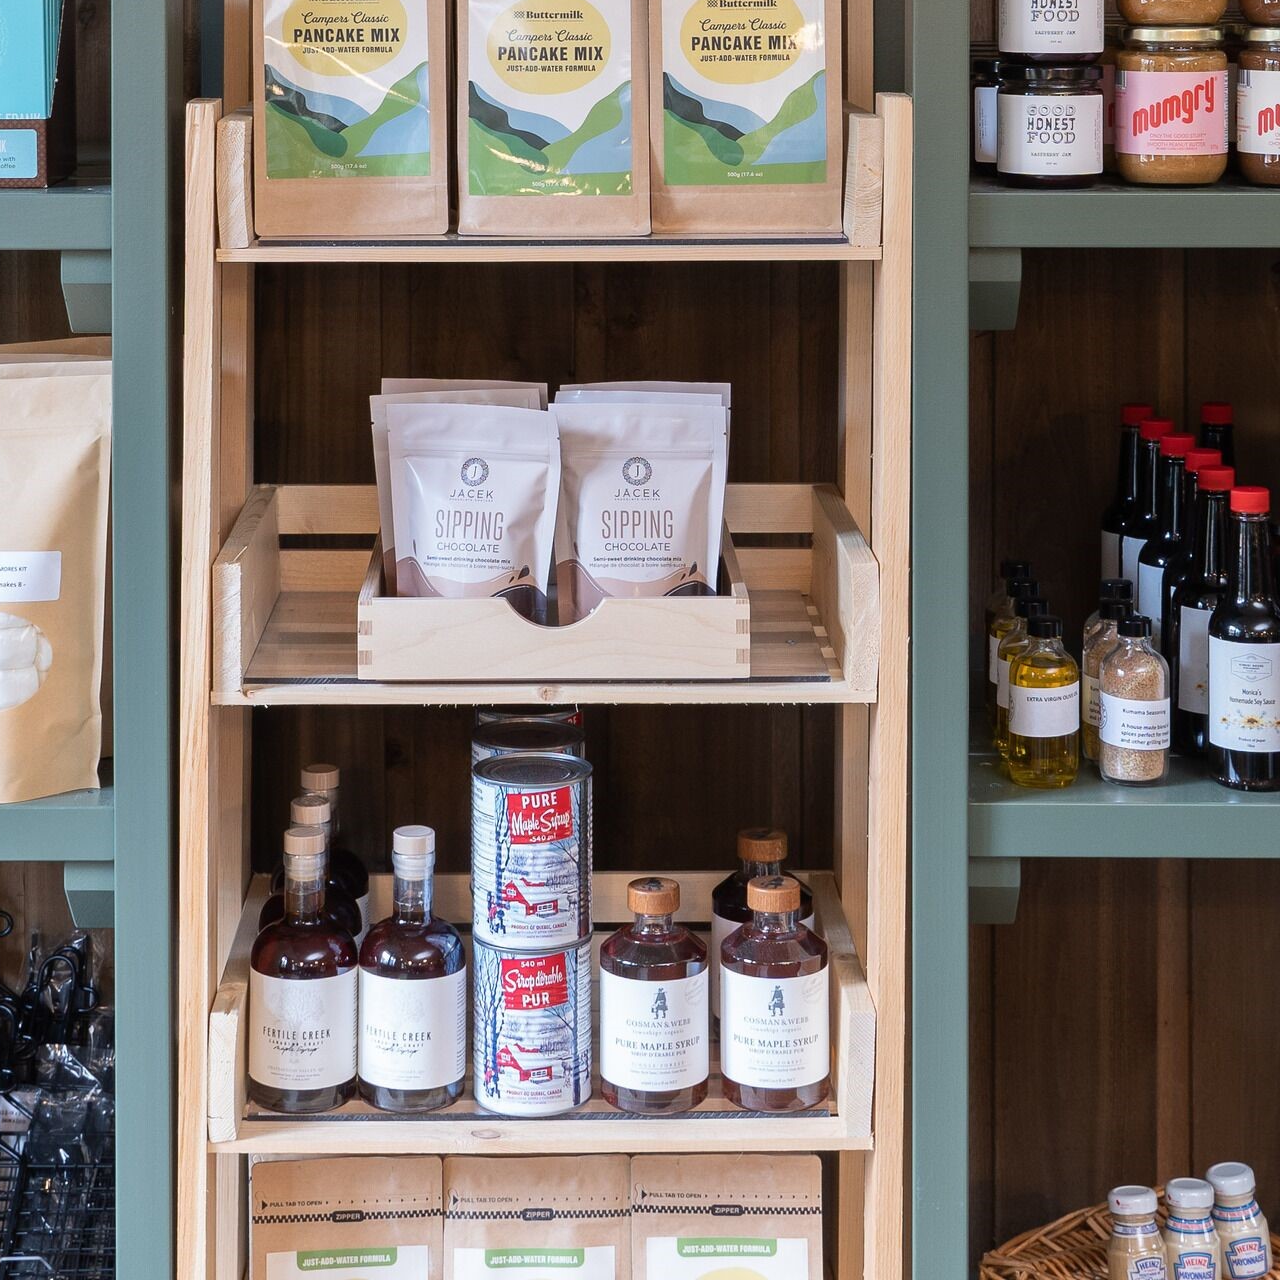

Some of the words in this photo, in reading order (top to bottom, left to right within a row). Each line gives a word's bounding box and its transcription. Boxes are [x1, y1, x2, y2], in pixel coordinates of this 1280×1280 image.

[302, 12, 349, 26] Campers
[351, 11, 389, 23] Classic
[526, 11, 583, 19] Buttermilk
[1031, 10, 1080, 22] FOOD
[699, 19, 746, 33] Campers
[749, 18, 787, 31] Classic
[294, 29, 364, 42] PANCAKE
[371, 29, 400, 42] MIX
[692, 36, 761, 50] PANCAKE
[498, 47, 567, 61] PANCAKE
[575, 47, 603, 61] MIX
[1132, 77, 1214, 137] mumgry
[435, 509, 504, 540] SIPPING
[602, 509, 673, 539] SIPPING
[437, 542, 499, 553] CHOCOLATE
[605, 543, 670, 551] CHOCOLATE
[522, 792, 557, 809] PURE
[512, 812, 540, 835] Maple
[540, 809, 570, 832] Syrup
[505, 969, 535, 992] Sirop
[522, 992, 549, 1008] PUR
[263, 1026, 297, 1040] FERTILE
[302, 1028, 331, 1040] CREEK
[615, 1037, 638, 1049] PURE
[641, 1042, 673, 1051] MAPLE
[675, 1036, 700, 1050] SYRUP
[334, 1212, 361, 1221] ZIPPER
[1236, 1244, 1257, 1253] HEINZ
[490, 1256, 546, 1265] JUST-ADD-WATER
[546, 1255, 578, 1265] FORMULA
